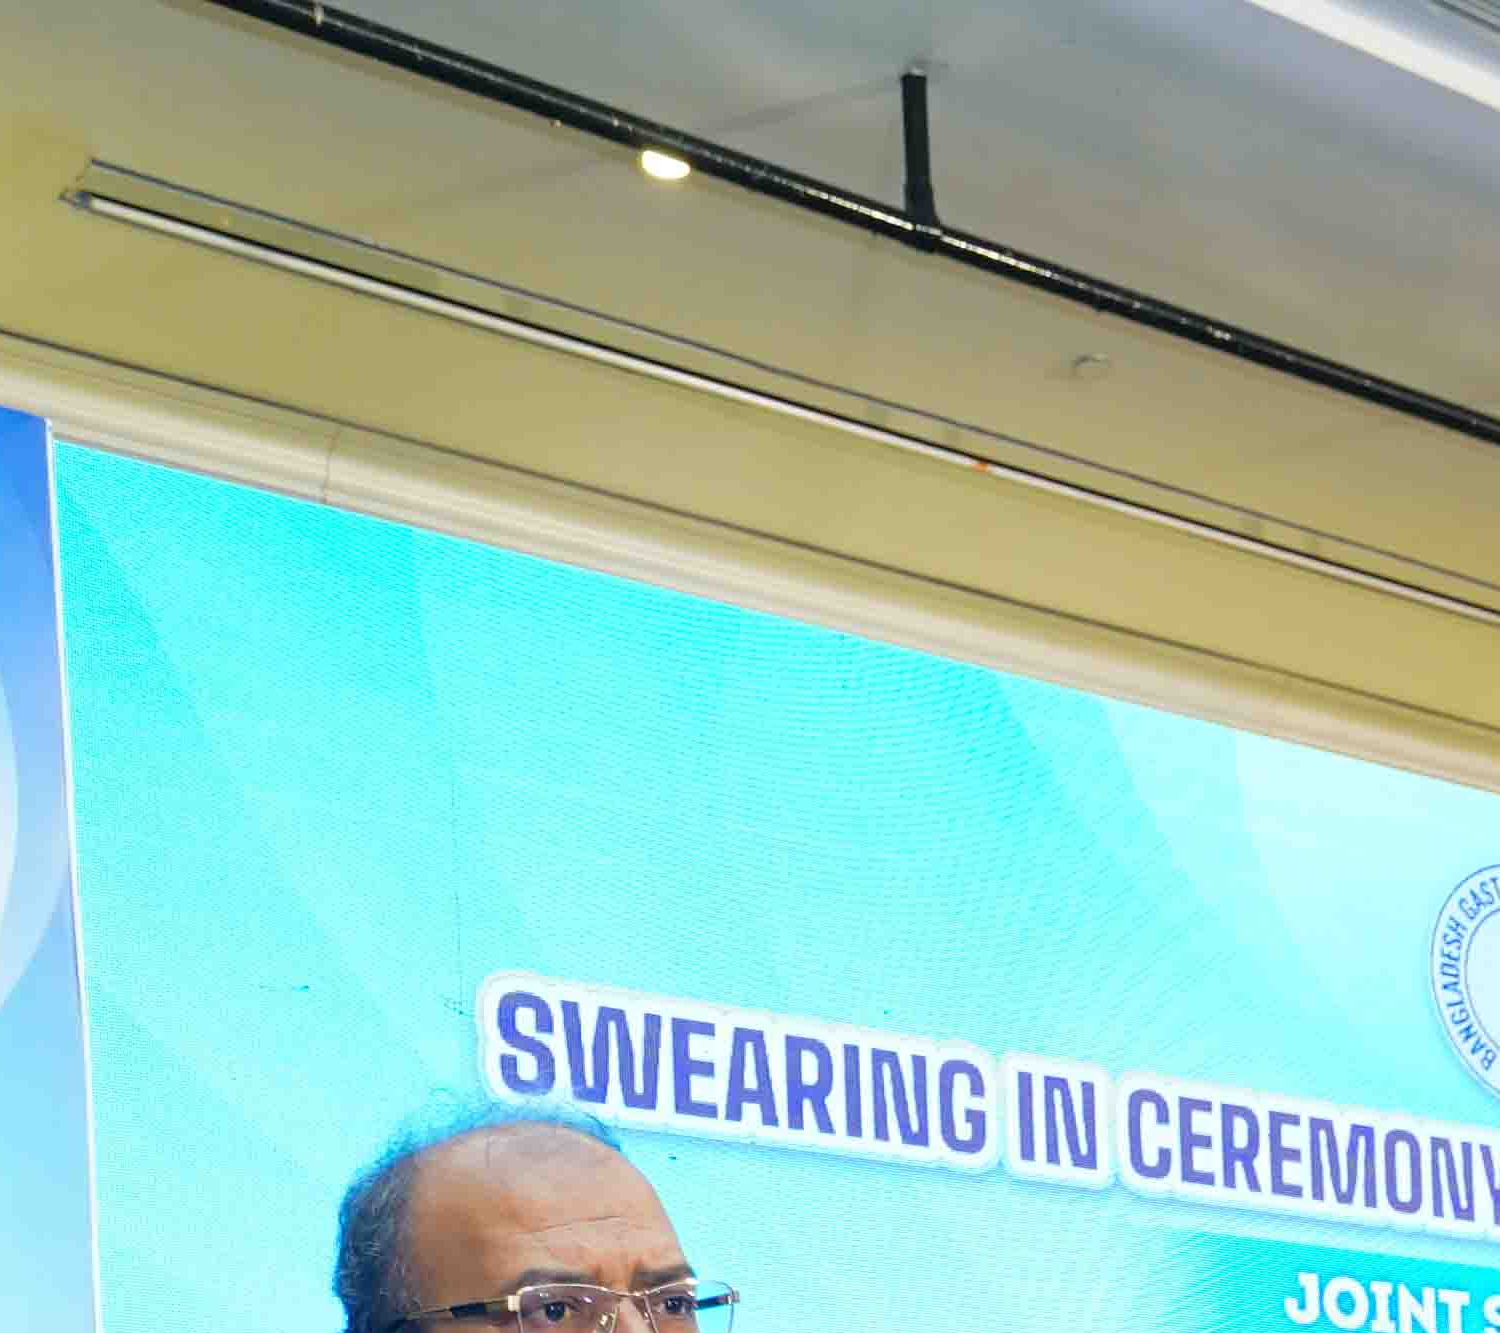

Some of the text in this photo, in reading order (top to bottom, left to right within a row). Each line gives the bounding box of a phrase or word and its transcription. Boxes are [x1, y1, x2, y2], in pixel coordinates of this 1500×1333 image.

[1440, 917, 1497, 1071] BANGLADESH
[497, 989, 988, 1155] SWEARING
[1016, 1063, 1098, 1171] IN
